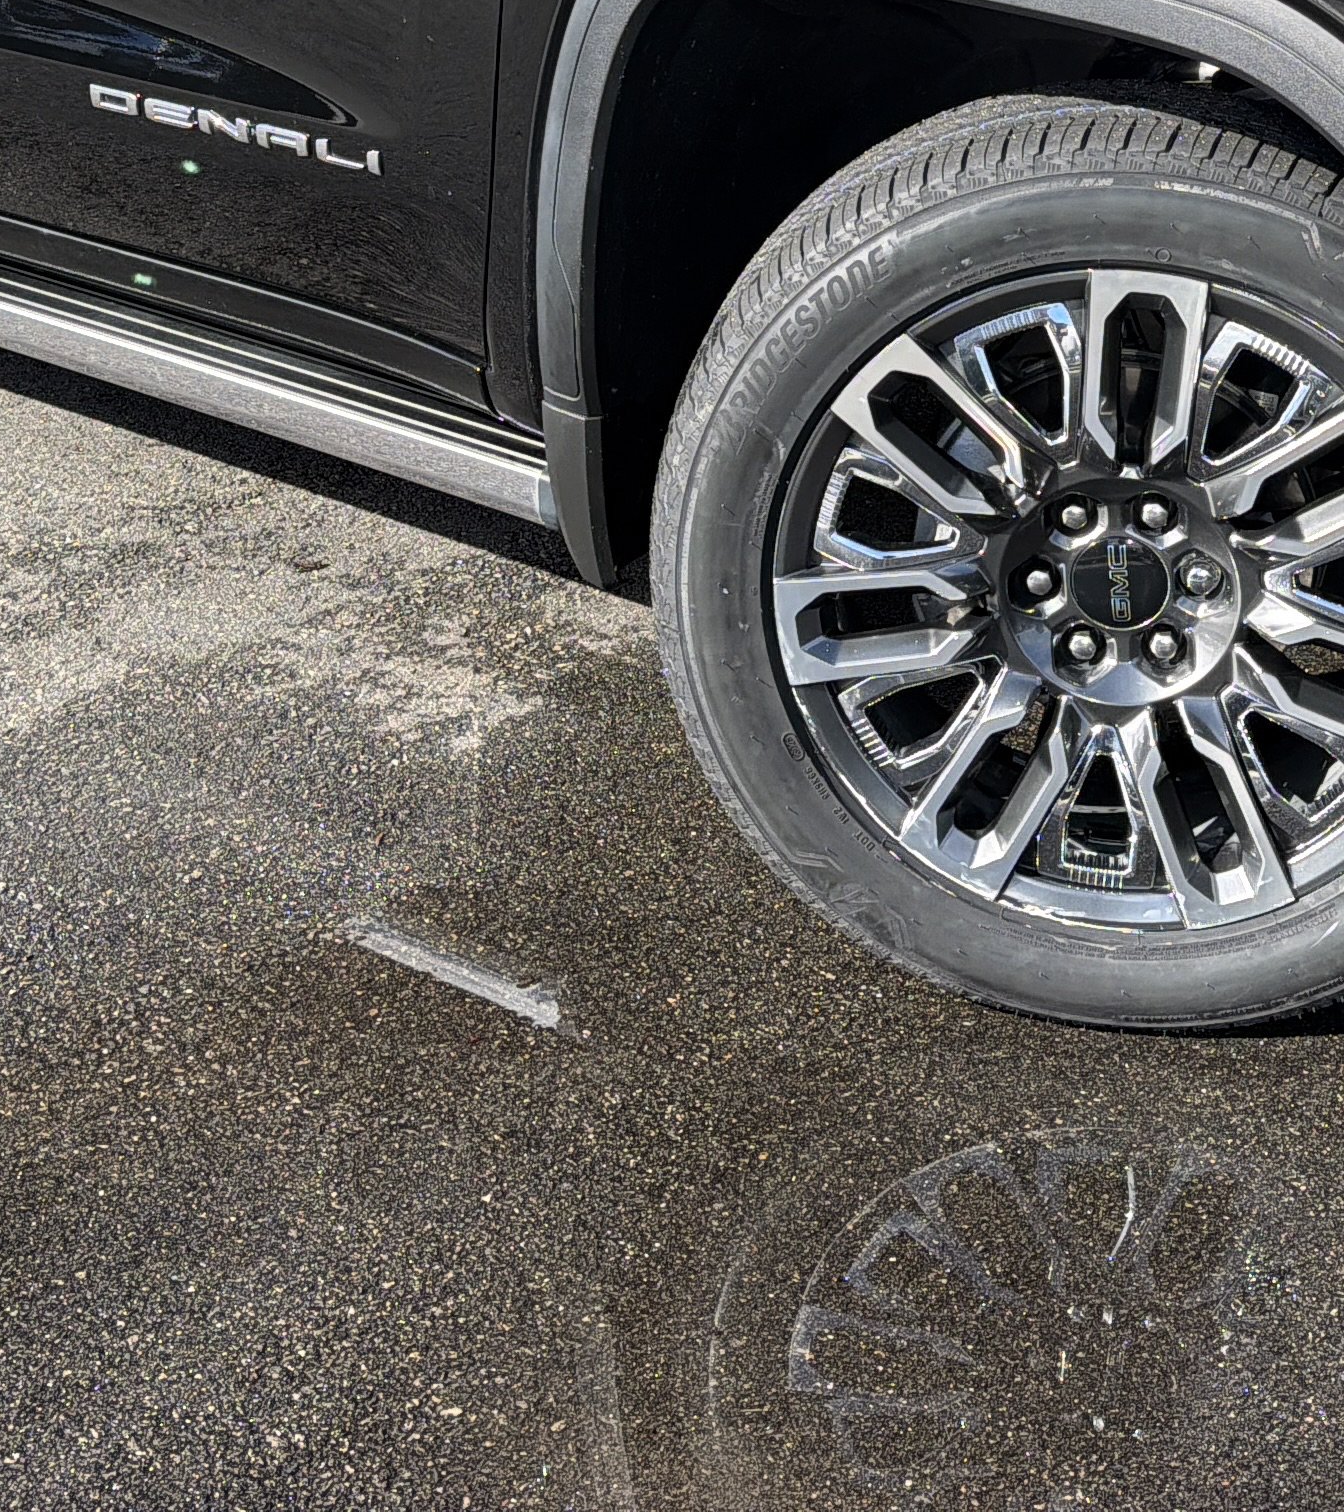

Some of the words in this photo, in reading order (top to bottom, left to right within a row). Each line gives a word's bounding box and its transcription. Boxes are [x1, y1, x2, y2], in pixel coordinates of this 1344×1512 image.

[89, 83, 384, 176] DENALI
[716, 244, 892, 456] BRIDGESTONE
[1107, 543, 1131, 623] GMC
[855, 831, 876, 851] DOT
